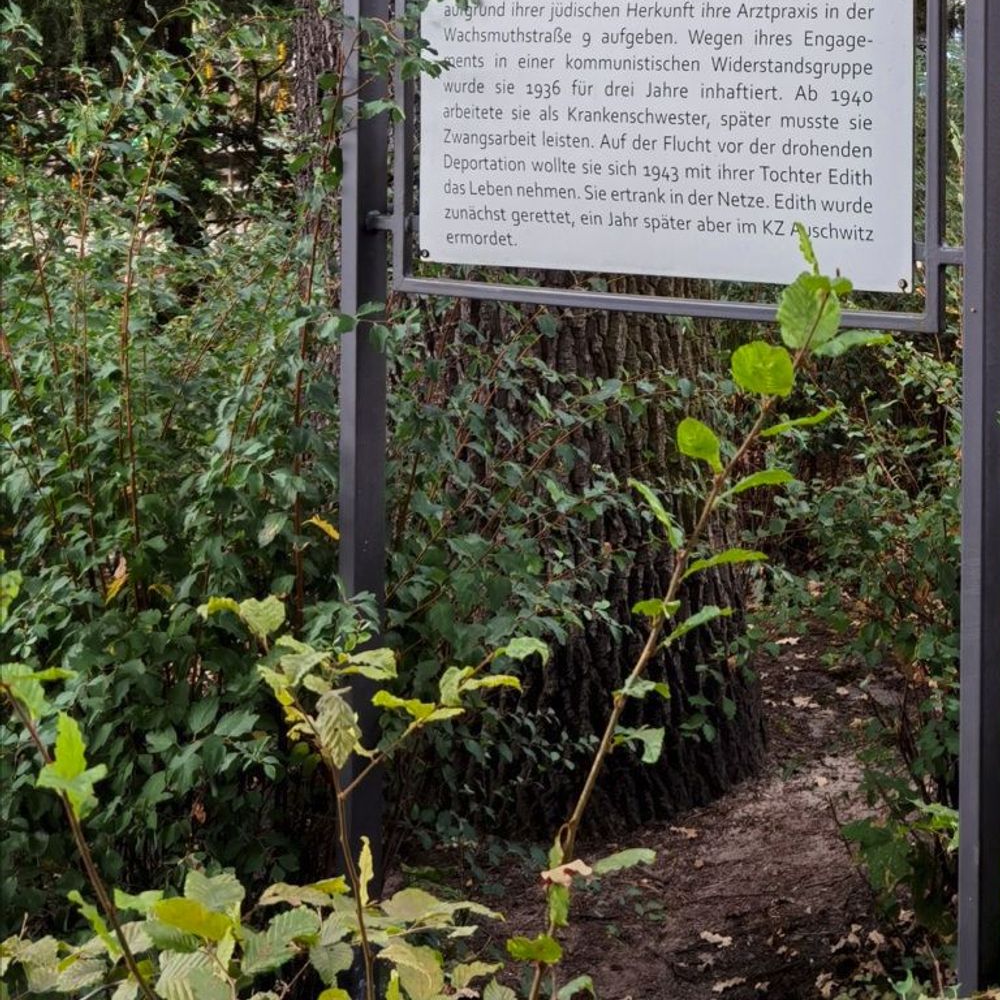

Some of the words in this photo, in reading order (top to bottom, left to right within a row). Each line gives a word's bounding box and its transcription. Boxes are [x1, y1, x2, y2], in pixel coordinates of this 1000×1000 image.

[512, 2, 545, 17] ihrer
[548, 2, 619, 22] jüdischen
[627, 2, 694, 18] Herkunft
[702, 2, 731, 18] ihre
[737, 3, 818, 23] Arztpraxis
[825, 3, 838, 19] in
[846, 2, 874, 20] der
[444, 26, 571, 43] Wachsmuthstraße
[582, 32, 591, 48] 9
[602, 27, 677, 49] aufgeben.
[688, 30, 742, 50] Wegen
[754, 29, 792, 46] ihres
[804, 30, 873, 52] Engage-
[495, 53, 507, 68] in
[518, 54, 555, 69] einer
[566, 53, 700, 71] kommunistischen
[711, 56, 872, 80] Widerstandsgruppe
[444, 78, 484, 93] wurde
[496, 80, 514, 94] sie
[526, 80, 560, 99] 1936
[572, 80, 593, 96] für
[604, 80, 634, 97] drei
[646, 82, 688, 98] Jahre
[701, 82, 782, 100] inhaftiert.
[795, 84, 818, 101] Ab
[831, 90, 873, 106] 1940
[443, 103, 503, 120] arbeitete
[512, 105, 530, 120] sie
[539, 105, 558, 121] als
[568, 106, 710, 129] Krankenschwester,
[720, 111, 771, 131] später
[780, 115, 839, 130] musste
[850, 114, 872, 130] sie
[444, 128, 536, 150] Zwangsarbeit
[542, 131, 594, 148] leisten.
[600, 133, 627, 150] Auf
[632, 134, 658, 150] der
[664, 136, 711, 153] Flucht
[718, 142, 744, 153] vor
[750, 138, 776, 154] der
[782, 138, 872, 158] drohenden
[444, 154, 525, 173] Deportation
[532, 157, 576, 174] wollte
[582, 160, 602, 175] sie
[608, 160, 636, 176] sich
[643, 166, 679, 182] 1943
[685, 164, 711, 180] mit
[718, 163, 755, 181] ihrer
[759, 166, 822, 184] Tochter
[828, 168, 872, 186] Edith
[444, 179, 466, 195] das
[470, 180, 512, 196] Leben
[517, 182, 580, 199] nehmen.
[584, 185, 606, 200] Sie
[611, 188, 665, 203] ertrank
[670, 189, 683, 204] in
[688, 189, 713, 206] der
[718, 191, 769, 208] Netze.
[775, 193, 816, 211] Edith
[821, 196, 872, 214] wurde
[445, 205, 506, 221] zunächst
[512, 210, 575, 228] gerettet,
[580, 211, 602, 225] ein
[608, 212, 638, 227] Jahr
[644, 214, 692, 232] später
[697, 216, 731, 233] aber
[737, 218, 756, 234] im
[763, 220, 785, 236] KZ
[446, 230, 517, 246] ermordet.
